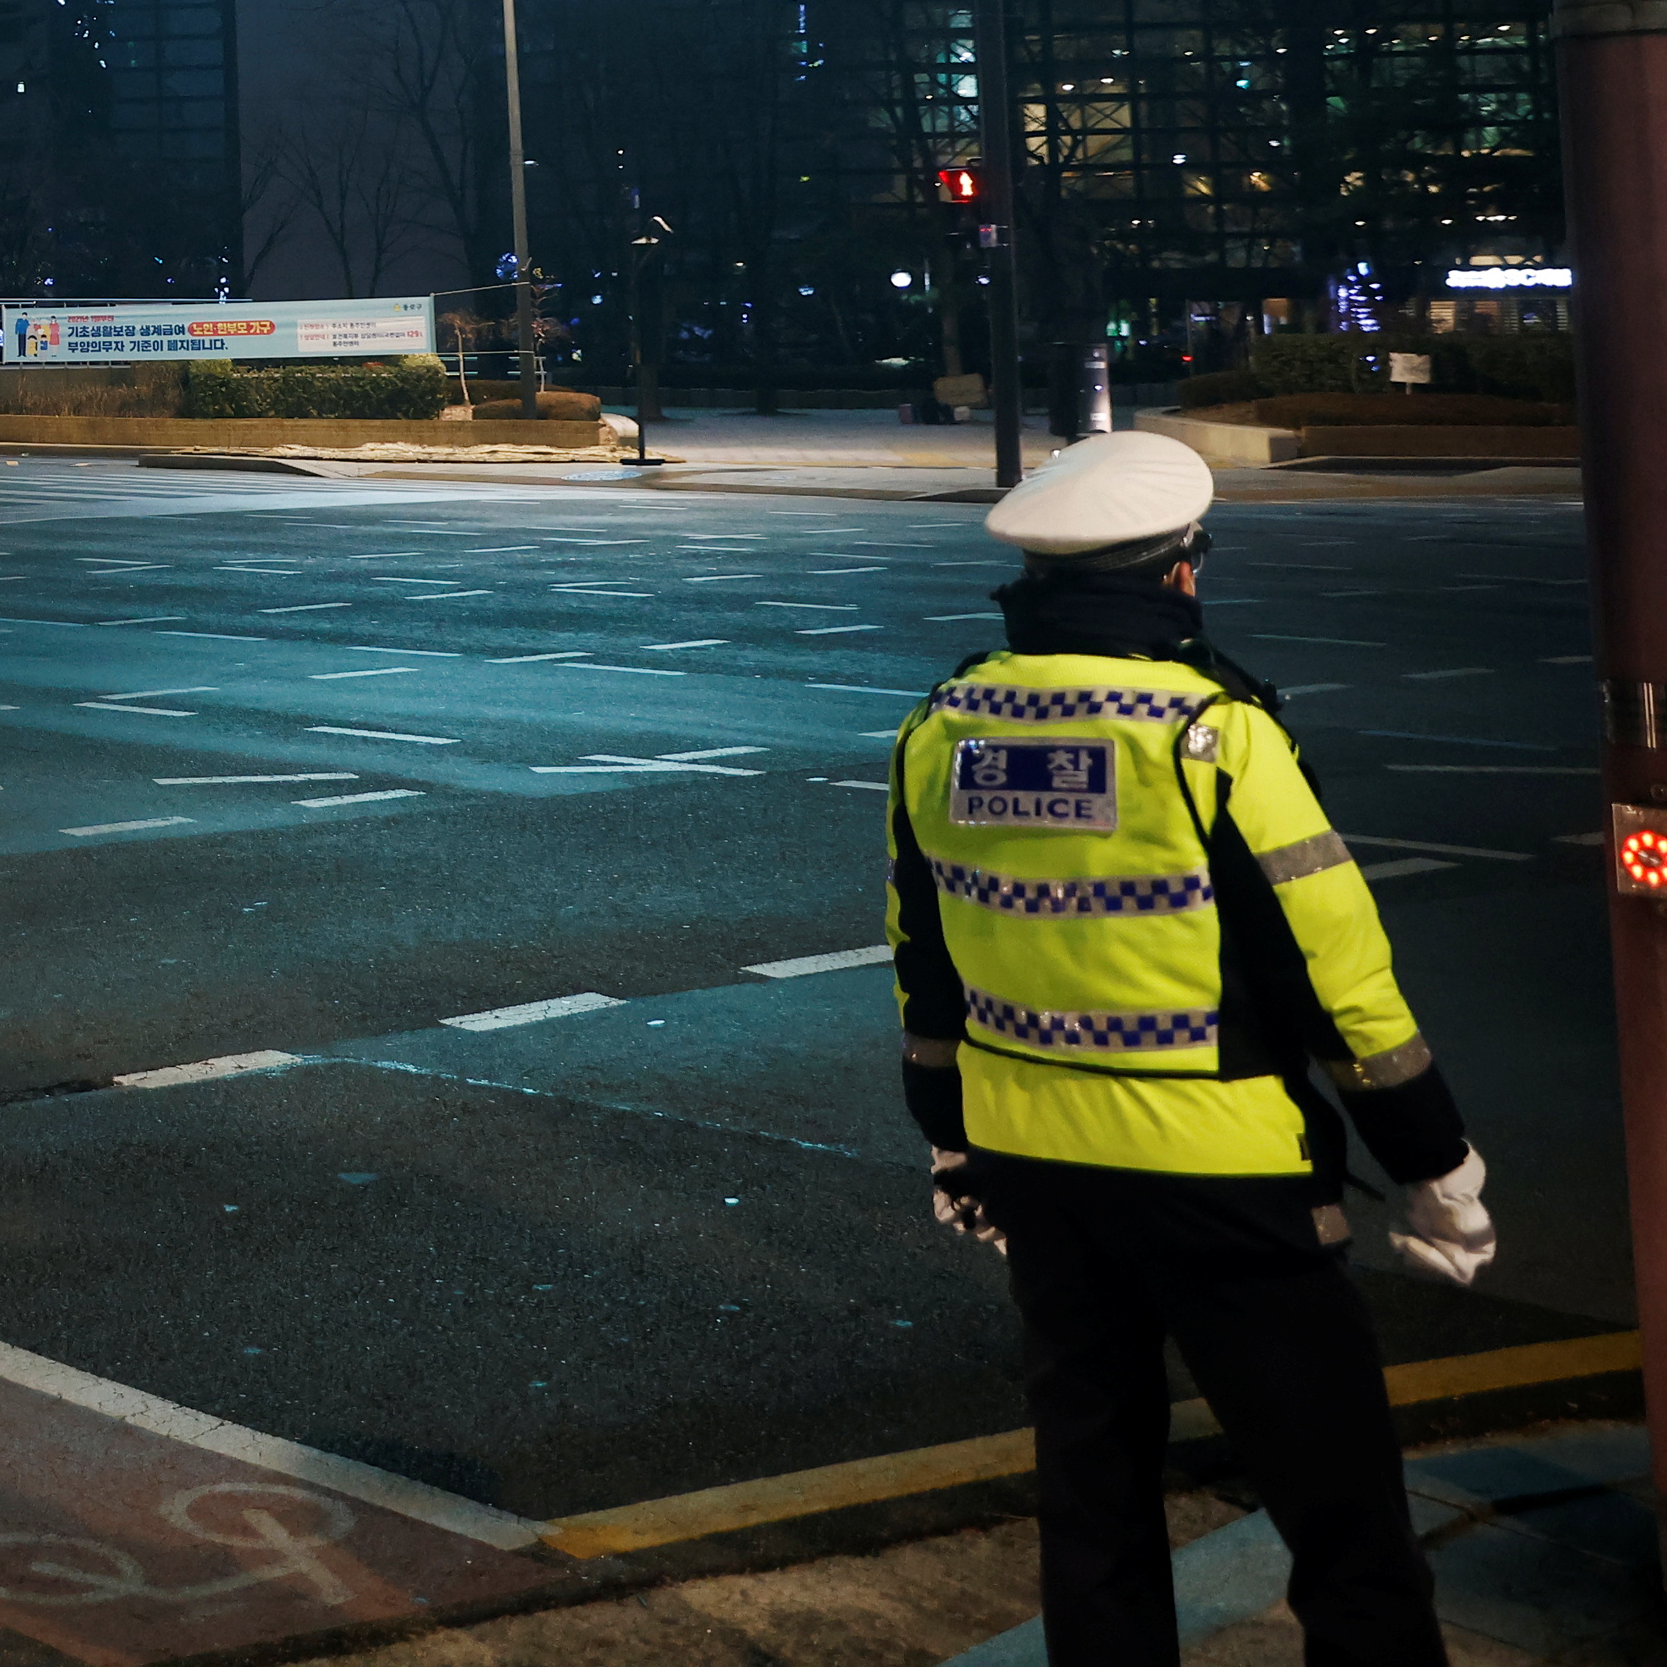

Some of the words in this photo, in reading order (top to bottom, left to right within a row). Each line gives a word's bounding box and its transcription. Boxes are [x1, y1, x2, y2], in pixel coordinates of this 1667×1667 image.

[67, 325, 136, 338] 기초생활보장
[139, 323, 186, 337] 생계급여
[249, 321, 271, 334] 가구
[67, 340, 125, 353] 부양의무자
[129, 339, 164, 352] 기준이
[971, 749, 1093, 789] 경찰
[968, 796, 1094, 820] POLICE
